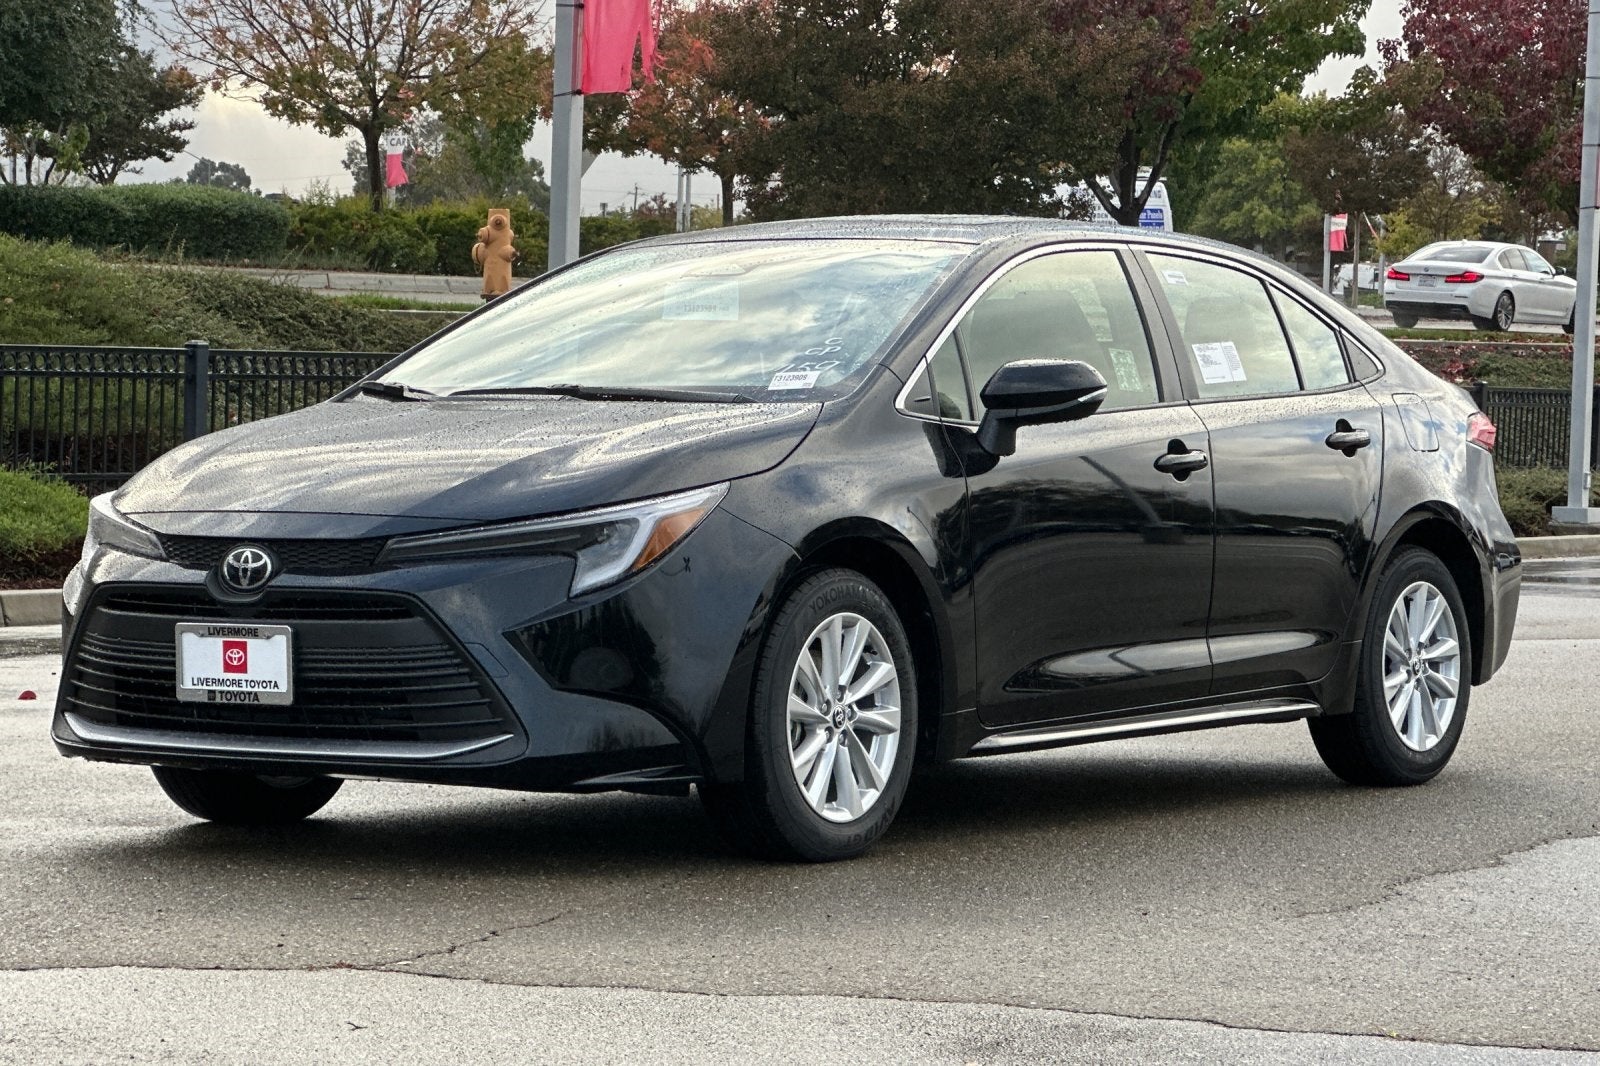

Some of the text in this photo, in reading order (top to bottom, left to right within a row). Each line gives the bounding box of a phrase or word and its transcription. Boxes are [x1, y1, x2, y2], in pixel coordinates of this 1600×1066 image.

[208, 626, 259, 637] LIVERMORE
[191, 677, 279, 690] LIVERMORE TOYOTA
[219, 691, 260, 702] TOYOTA
